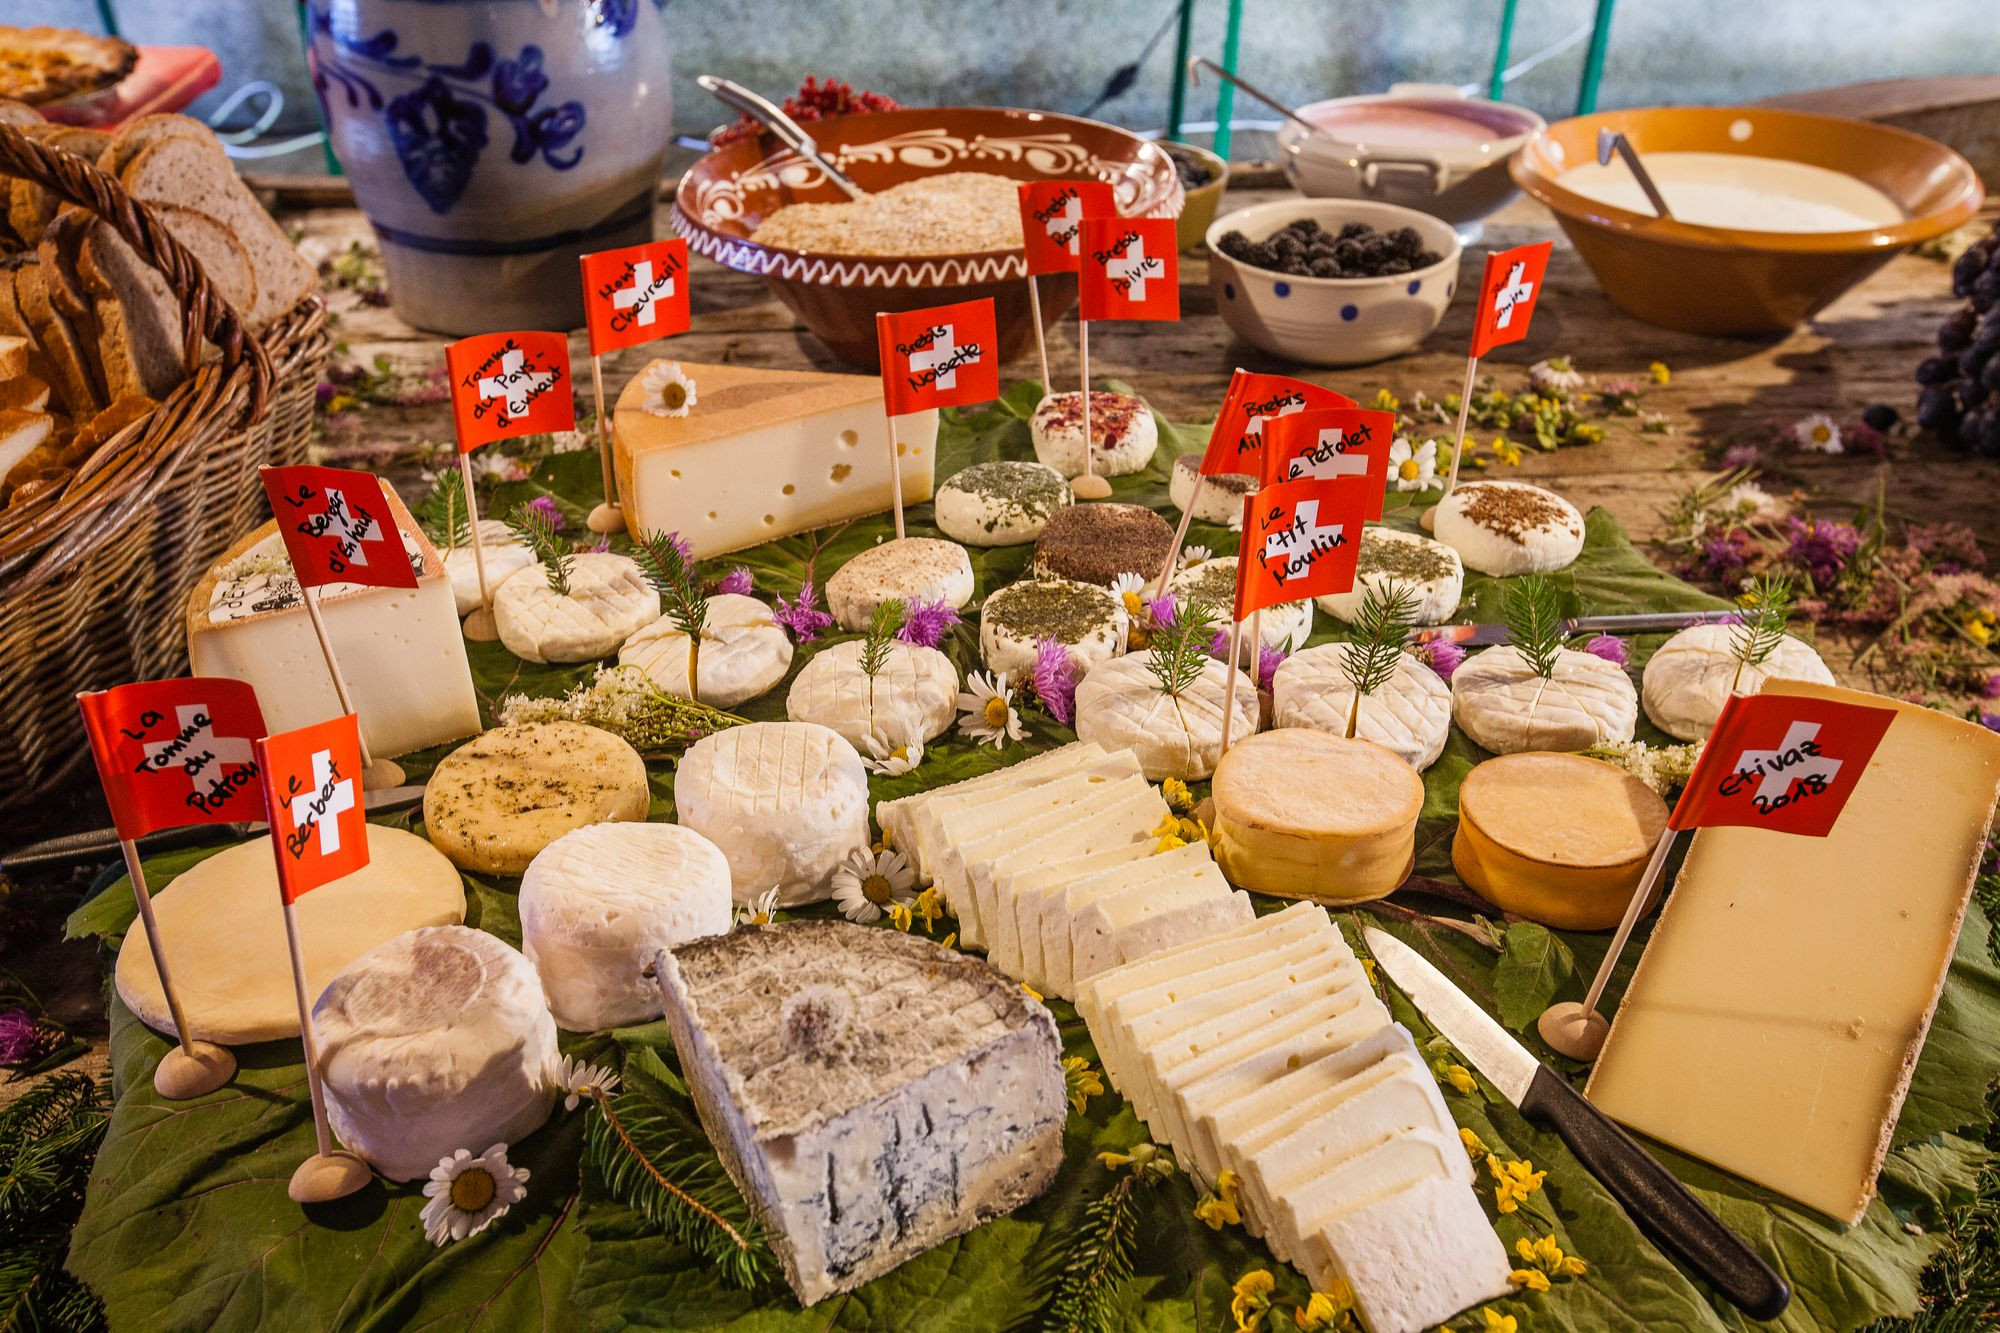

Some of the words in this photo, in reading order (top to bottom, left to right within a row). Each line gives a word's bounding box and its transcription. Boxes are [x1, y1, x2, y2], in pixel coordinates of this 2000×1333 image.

[1033, 187, 1078, 225] Brebis
[1092, 230, 1139, 266] Brebis
[598, 261, 637, 300] Mont
[610, 253, 682, 332] Chevreuil
[1111, 255, 1159, 296] Poivre
[896, 325, 947, 357] Brebis
[462, 338, 520, 388] Tomme
[907, 343, 986, 393] Noisette
[474, 395, 498, 419] du
[1243, 389, 1306, 418] Brebis
[1300, 424, 1372, 466] Petolet
[284, 485, 316, 507] Le
[297, 490, 348, 538] Berger
[1261, 506, 1286, 530] Le
[1273, 534, 1347, 587] Moulin
[121, 710, 164, 740] La
[135, 712, 213, 774] Tomme
[184, 750, 215, 777] du
[1719, 740, 1822, 797] Etivaz
[186, 761, 260, 815] Patron
[279, 774, 302, 810] Le
[1752, 773, 1828, 815] 2018
[286, 759, 341, 860] Berbert
